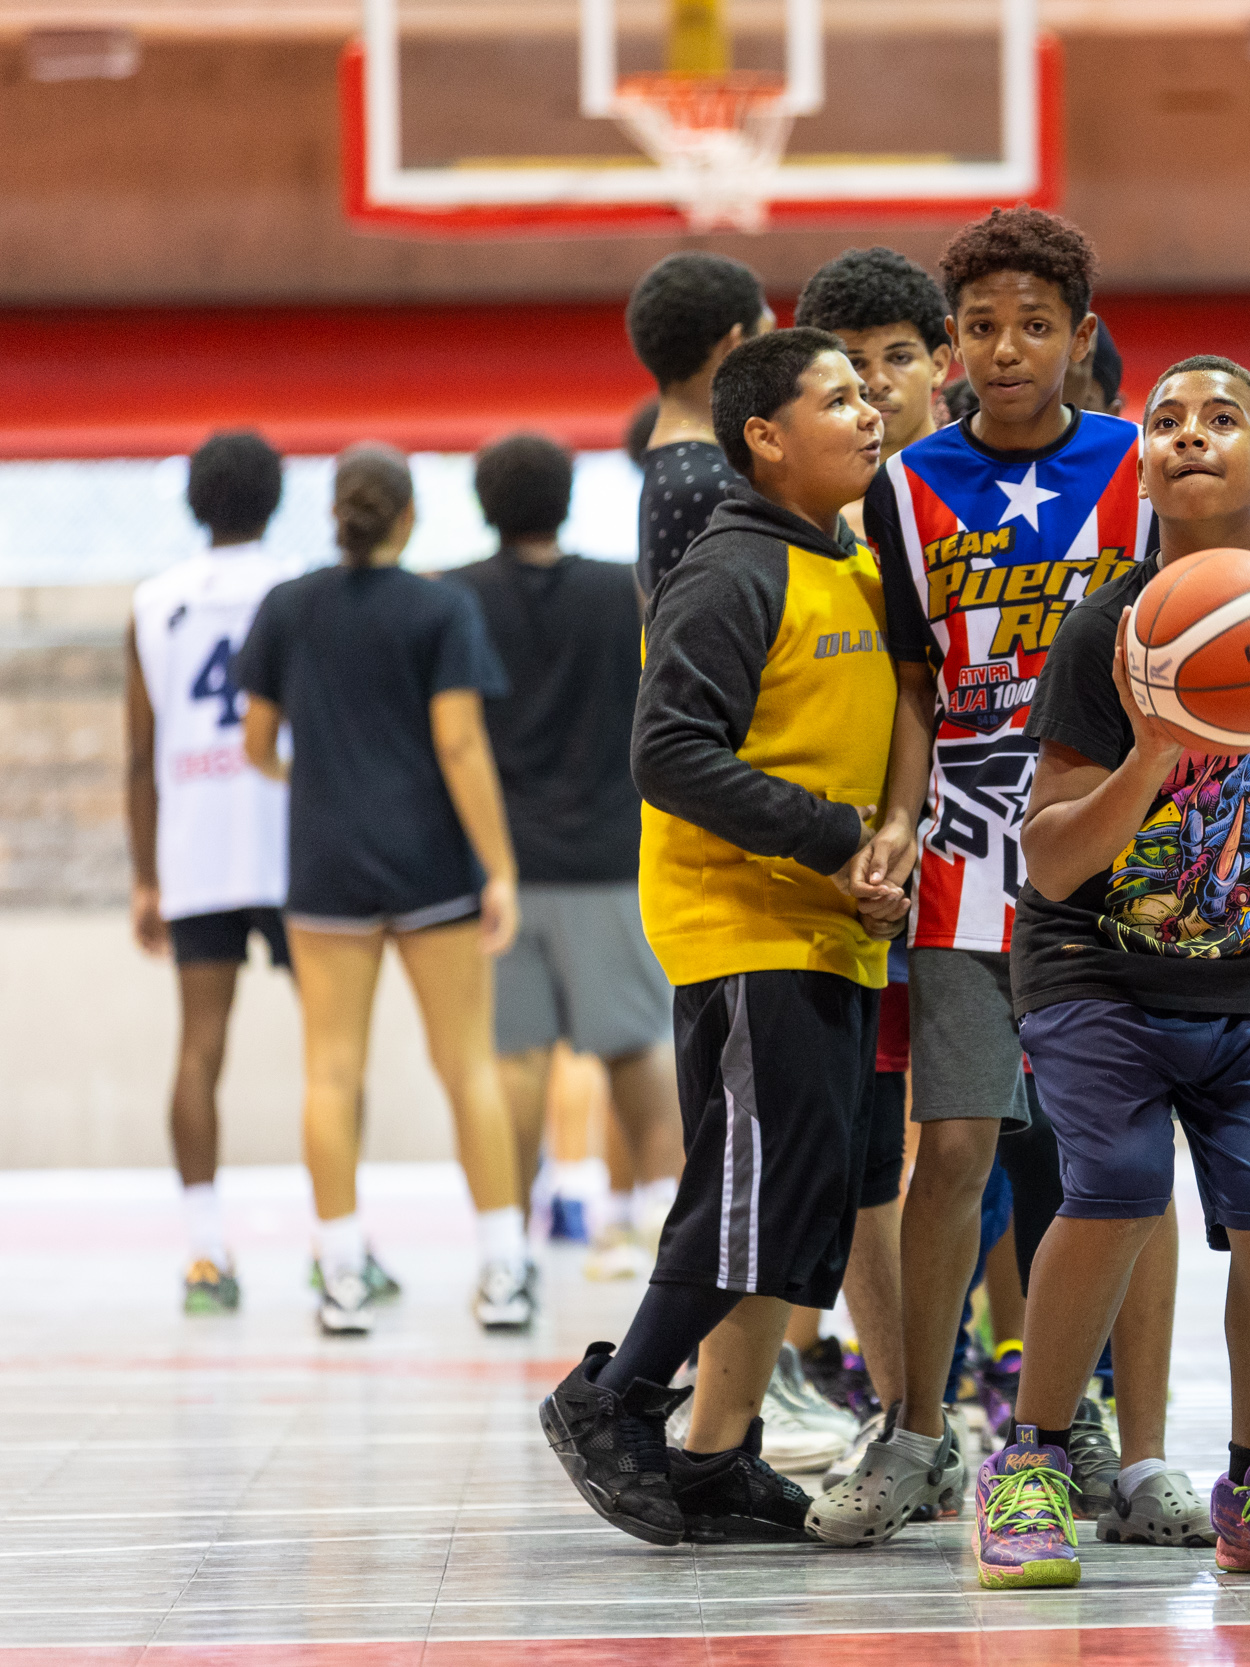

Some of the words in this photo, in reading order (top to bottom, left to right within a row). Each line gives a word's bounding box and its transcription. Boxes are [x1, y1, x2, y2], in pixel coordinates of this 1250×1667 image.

[923, 526, 1013, 568] TEAM
[813, 630, 873, 659] OLD
[192, 637, 243, 728] 4
[959, 667, 987, 686] ATV
[994, 678, 1037, 709] 1000
